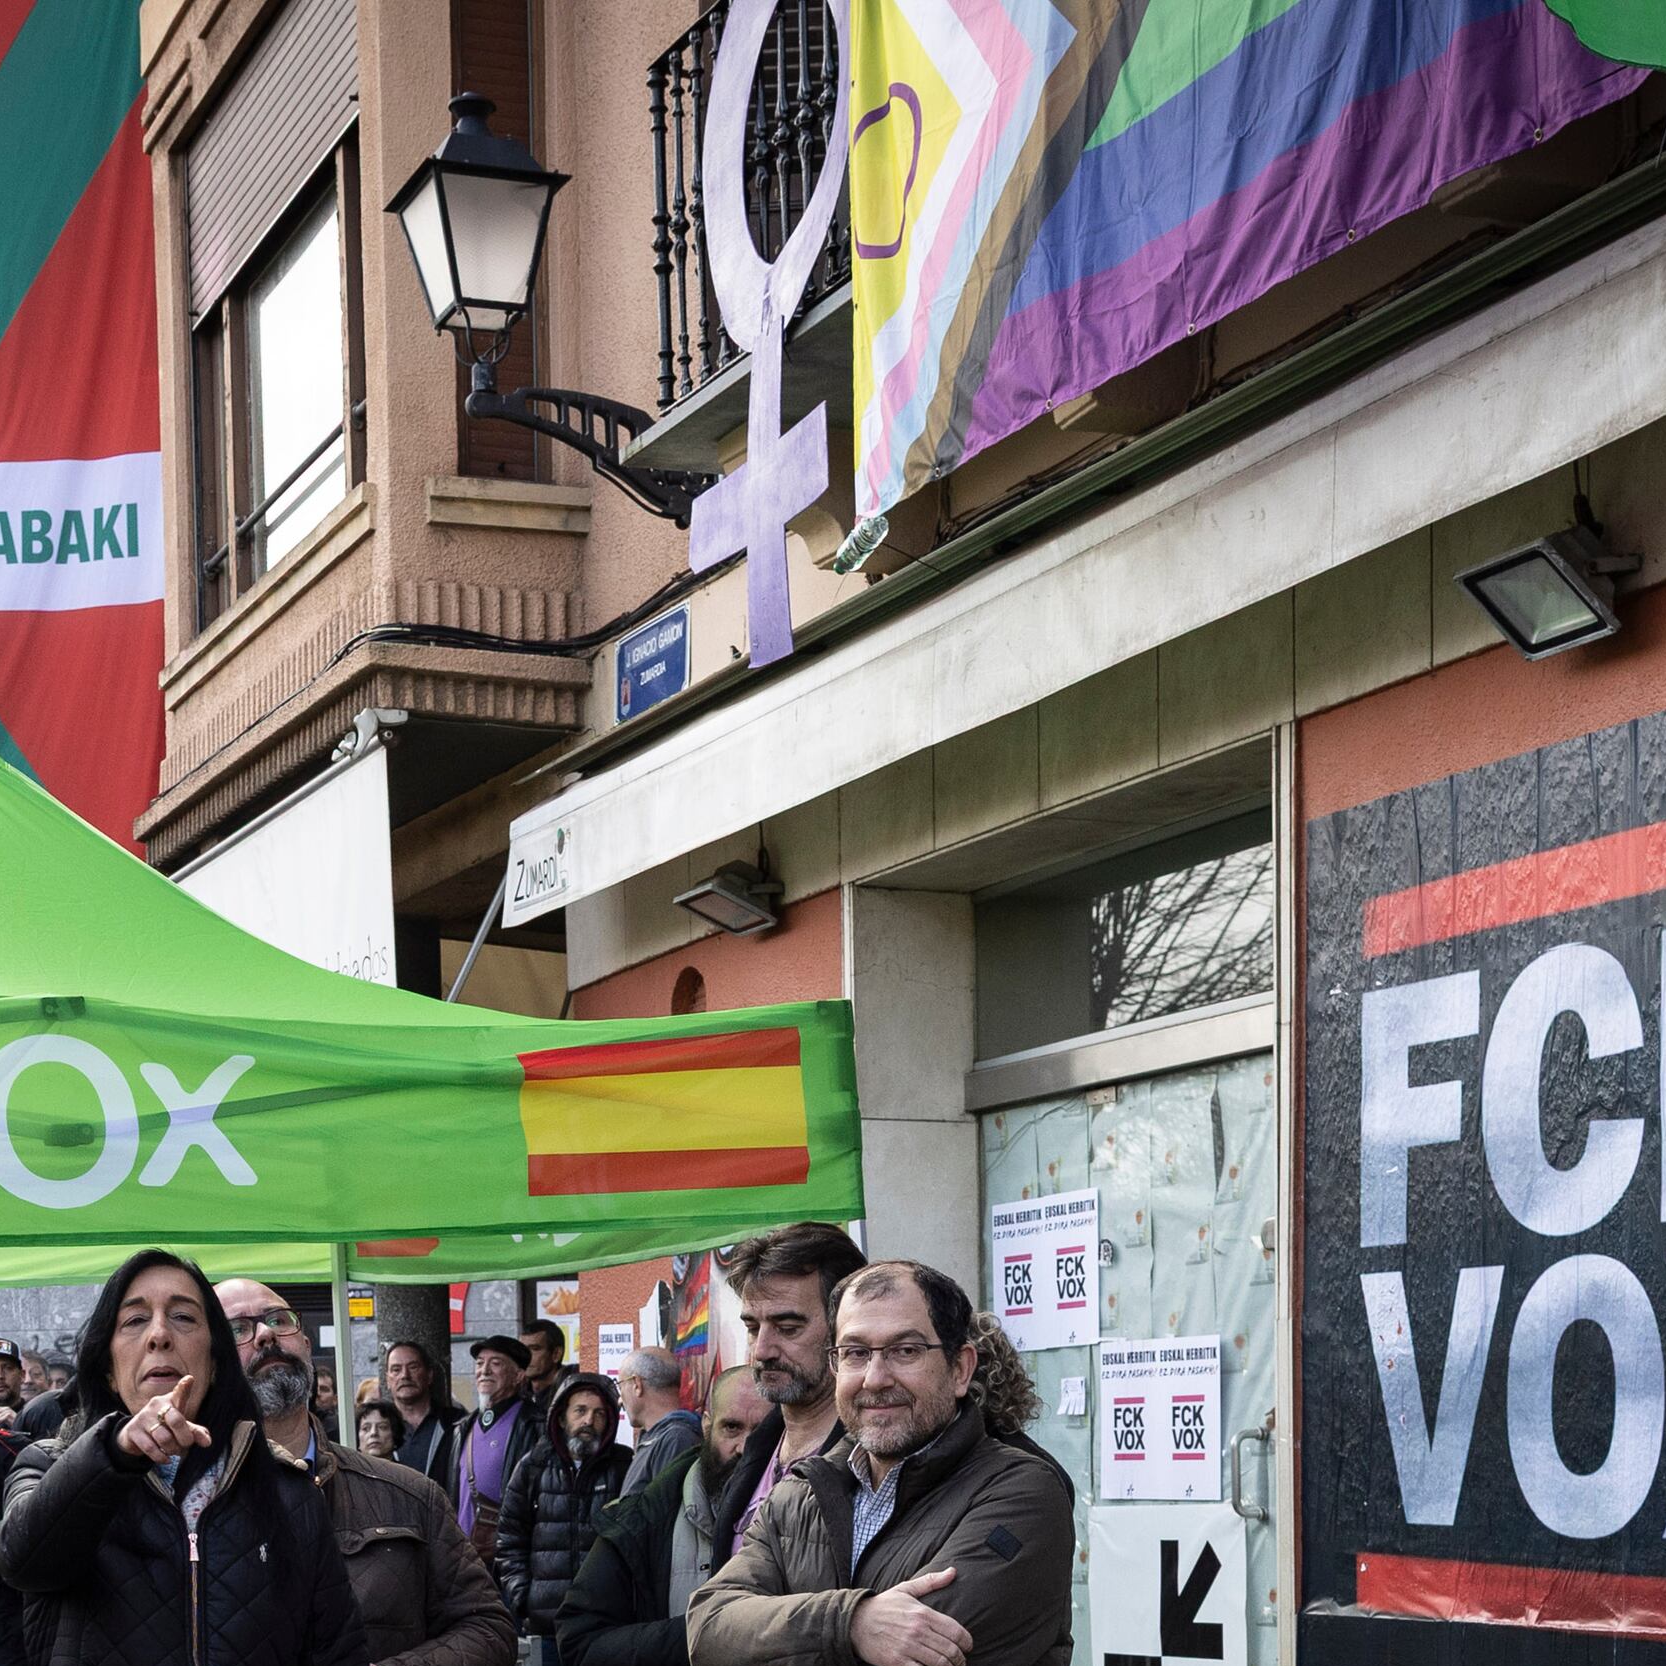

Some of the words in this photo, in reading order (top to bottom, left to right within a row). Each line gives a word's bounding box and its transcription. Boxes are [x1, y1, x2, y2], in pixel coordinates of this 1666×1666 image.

[994, 1213, 1015, 1227] EUSKAL
[1045, 1203, 1067, 1219] EUSKAL
[1004, 1263, 1032, 1286] FCK
[1056, 1255, 1085, 1278] FCK
[1005, 1284, 1033, 1306] VOX
[1056, 1277, 1086, 1300] VOX
[1102, 1352, 1125, 1366] EUSKAL
[1159, 1349, 1184, 1362] EUSKAL
[1114, 1407, 1144, 1428] FCK
[1172, 1405, 1204, 1427] FCK
[1114, 1429, 1145, 1450] VOX
[1172, 1428, 1205, 1449] VOX
